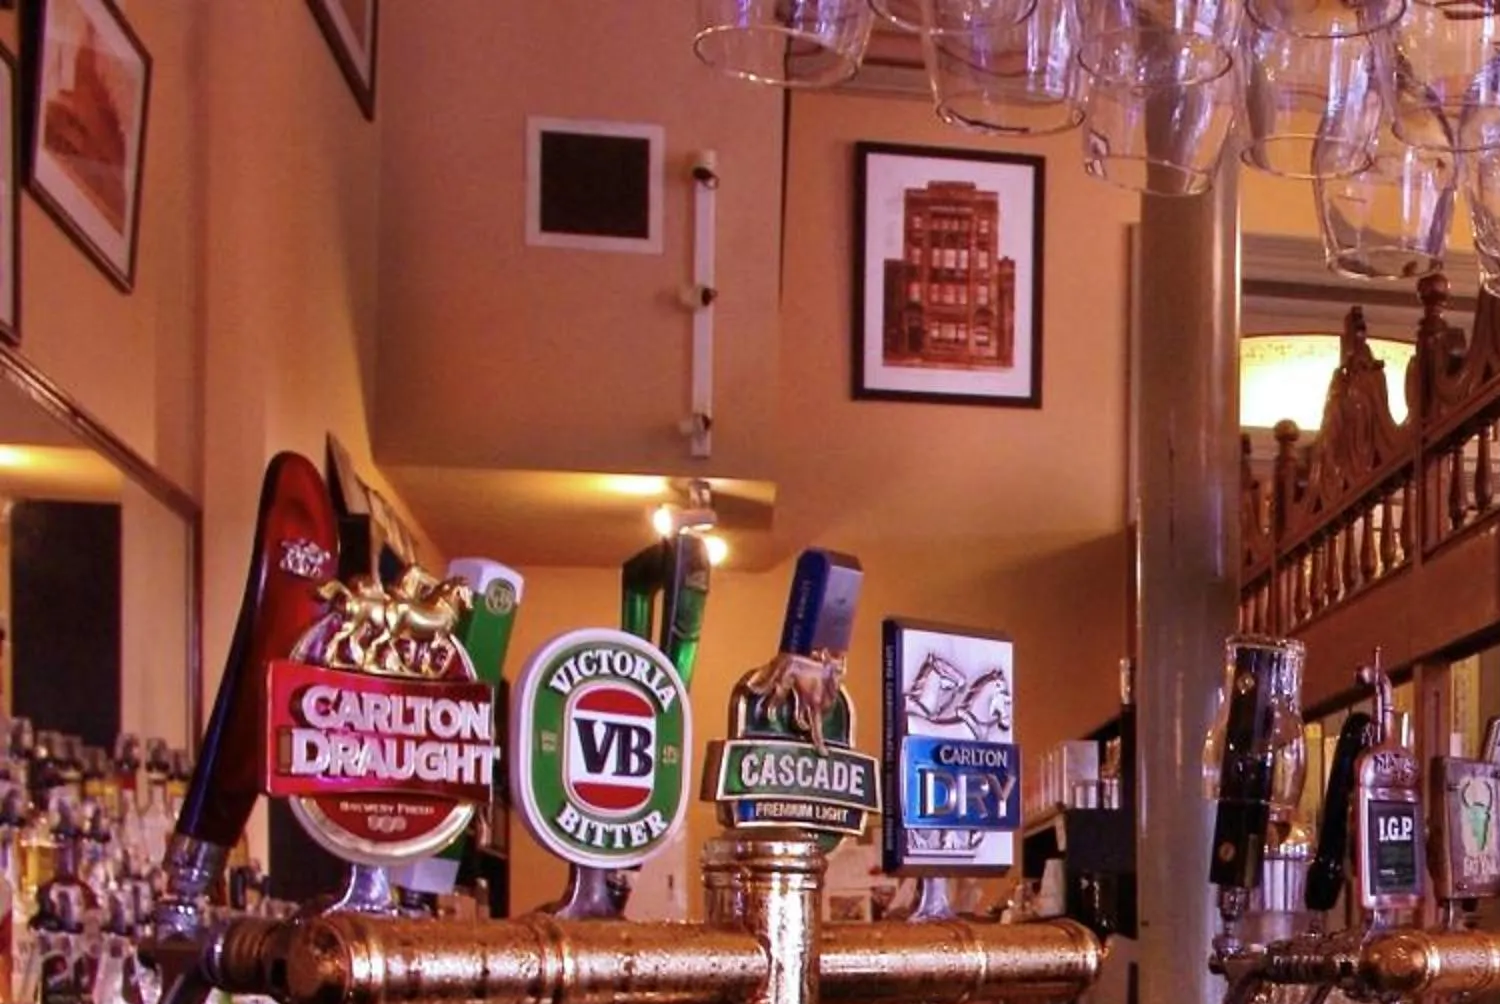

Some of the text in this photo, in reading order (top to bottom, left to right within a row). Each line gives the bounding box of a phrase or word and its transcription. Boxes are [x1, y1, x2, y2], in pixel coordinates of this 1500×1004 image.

[549, 649, 677, 713] VICTORIA
[301, 684, 492, 740] CARLTON
[291, 727, 501, 785] DRAUGHT
[573, 717, 654, 778] VB
[939, 744, 1008, 768] CARLTON
[741, 753, 865, 797] CASCADE
[922, 770, 1017, 818] DRY
[556, 802, 667, 849] BITTER
[755, 801, 849, 823] PREMIUM LIGHT
